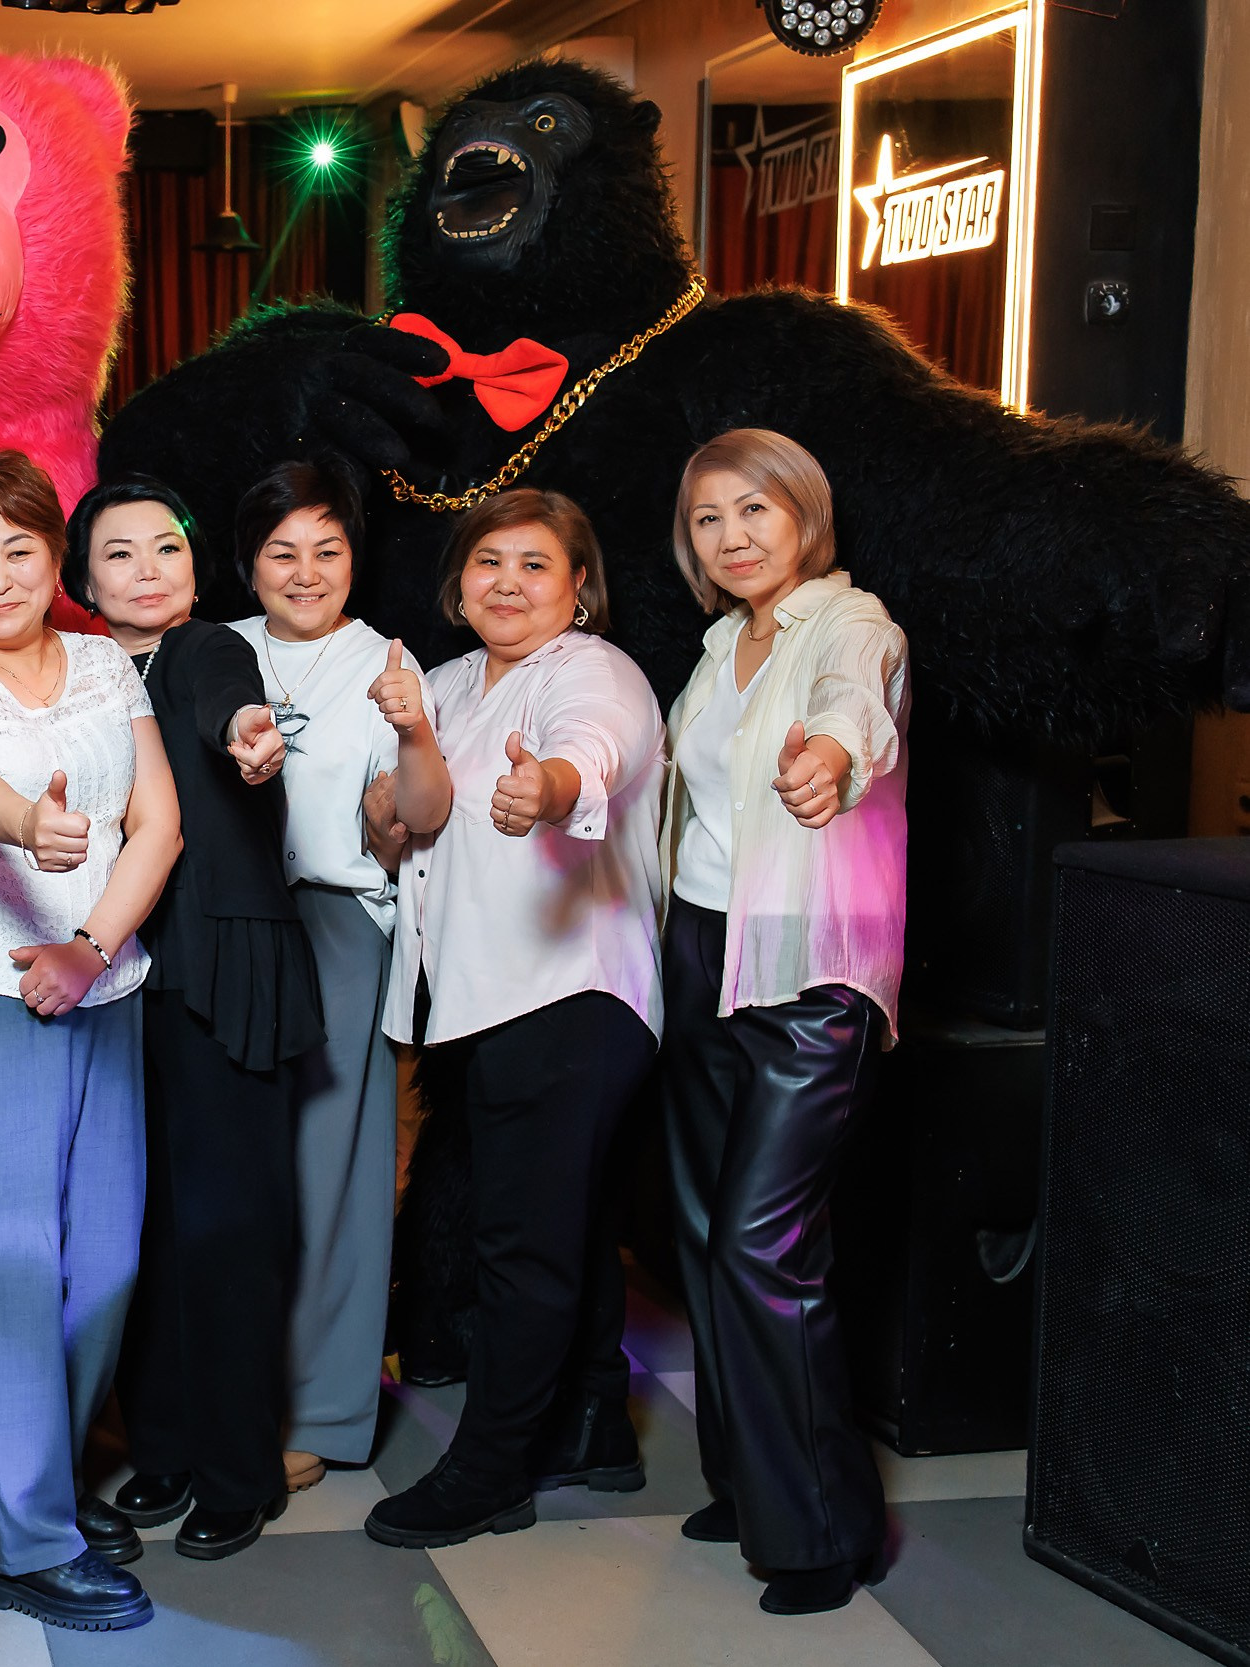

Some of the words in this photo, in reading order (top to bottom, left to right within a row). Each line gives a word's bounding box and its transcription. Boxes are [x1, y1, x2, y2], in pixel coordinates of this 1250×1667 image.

[760, 142, 805, 215] TWO
[883, 188, 937, 261] TWO
[936, 174, 1001, 252] STAR
